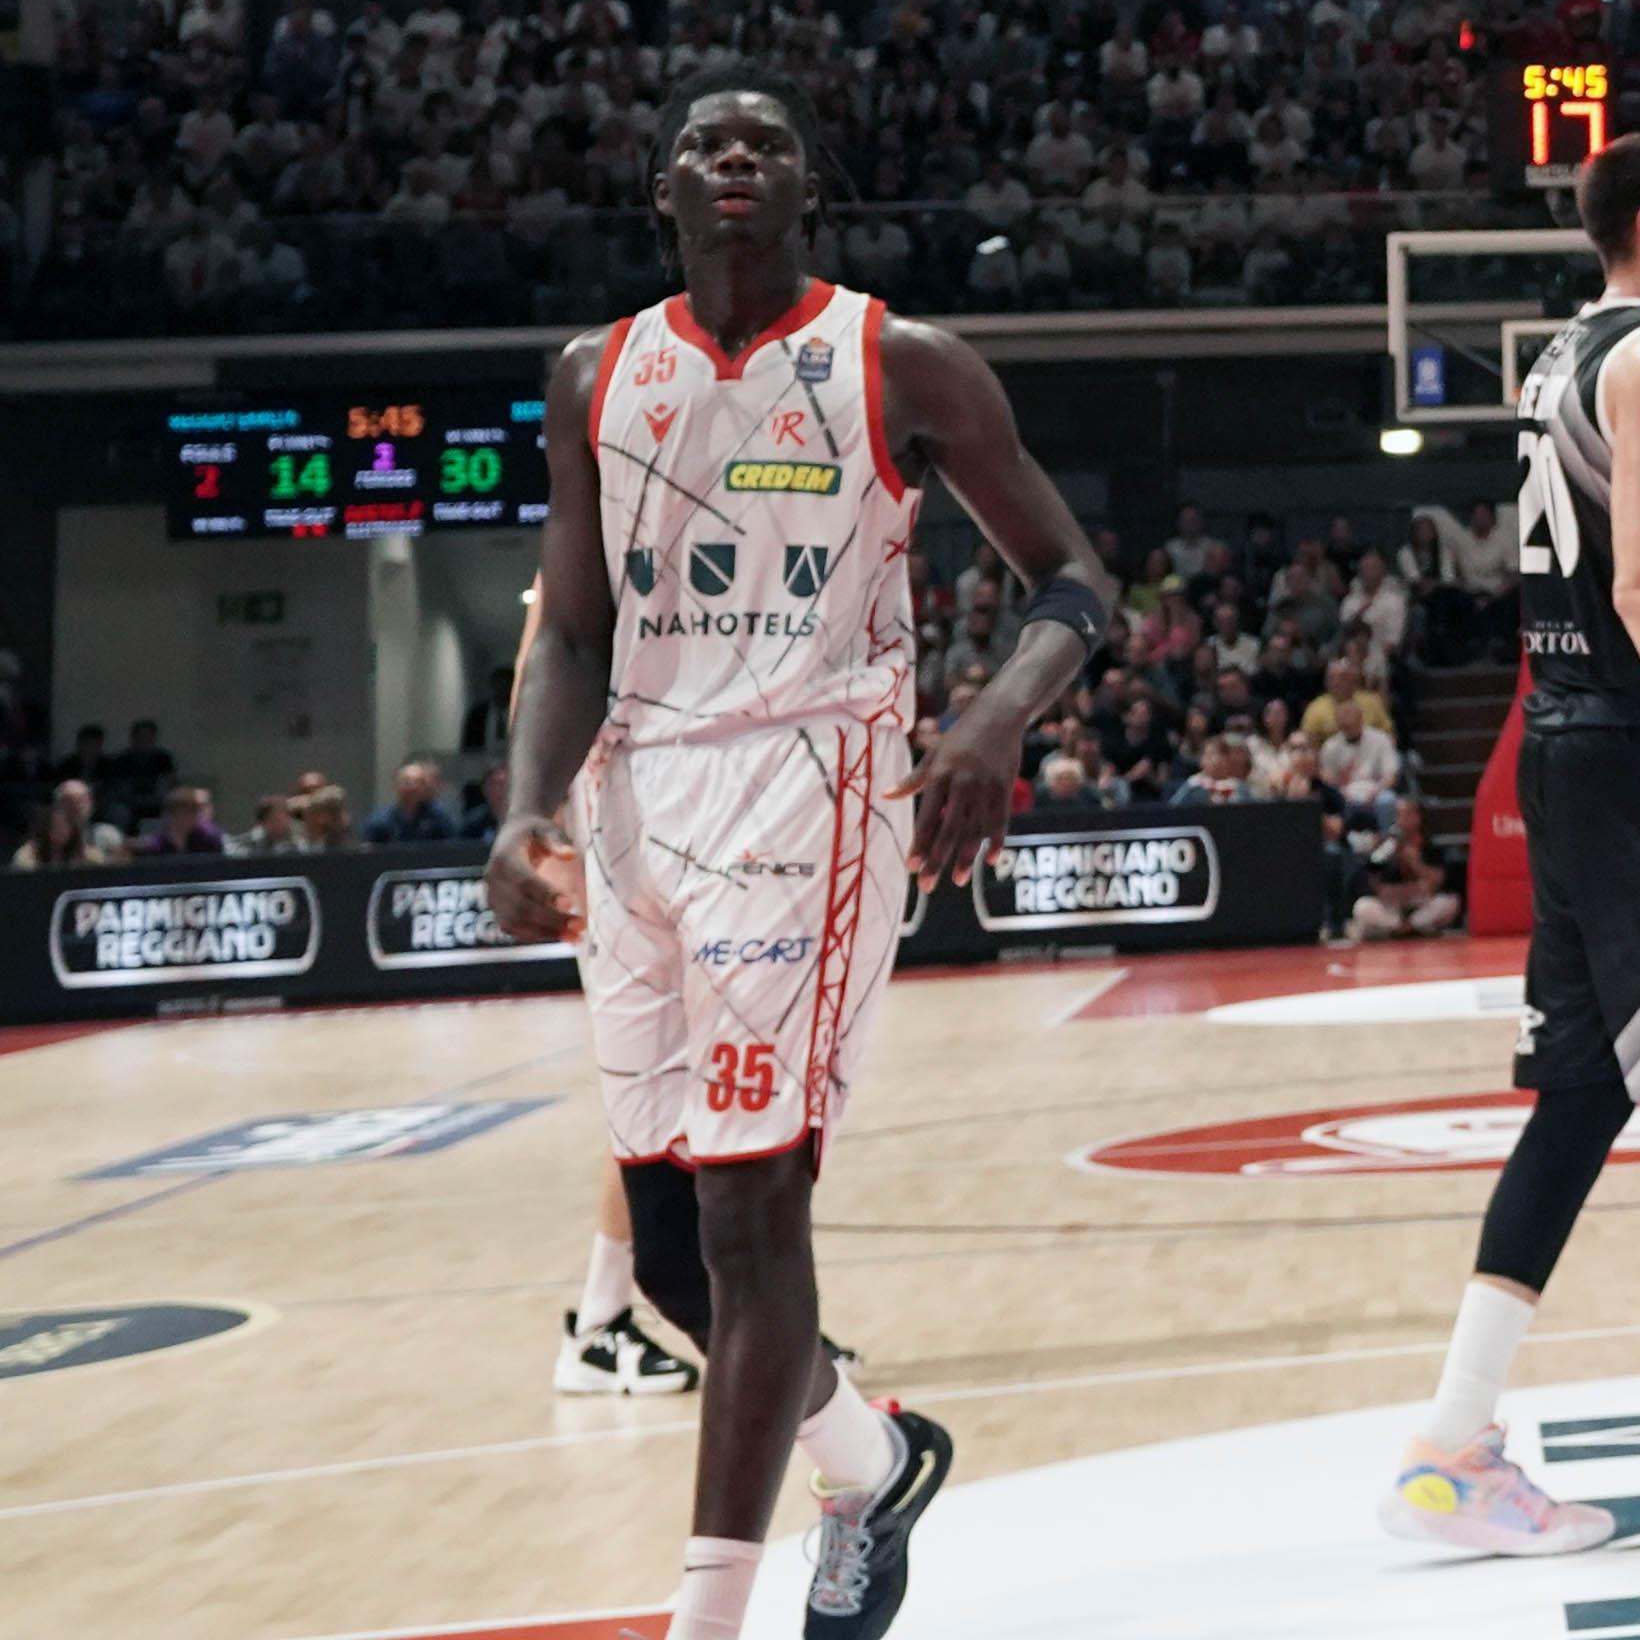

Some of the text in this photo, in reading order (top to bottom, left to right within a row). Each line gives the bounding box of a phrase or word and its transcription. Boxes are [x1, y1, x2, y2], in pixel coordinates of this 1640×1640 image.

[1523, 64, 1608, 100] 5:45
[1531, 101, 1606, 166] 17
[634, 348, 676, 386] 35
[269, 454, 331, 498] 14
[440, 448, 501, 494] 30
[729, 463, 836, 493] CREDEM
[994, 838, 1197, 881] PARMIGIANO
[74, 889, 297, 938] PARMIGIANO
[1014, 871, 1179, 912] REGGIANO
[97, 925, 276, 970] REGGIANO
[706, 1041, 776, 1112] 35
